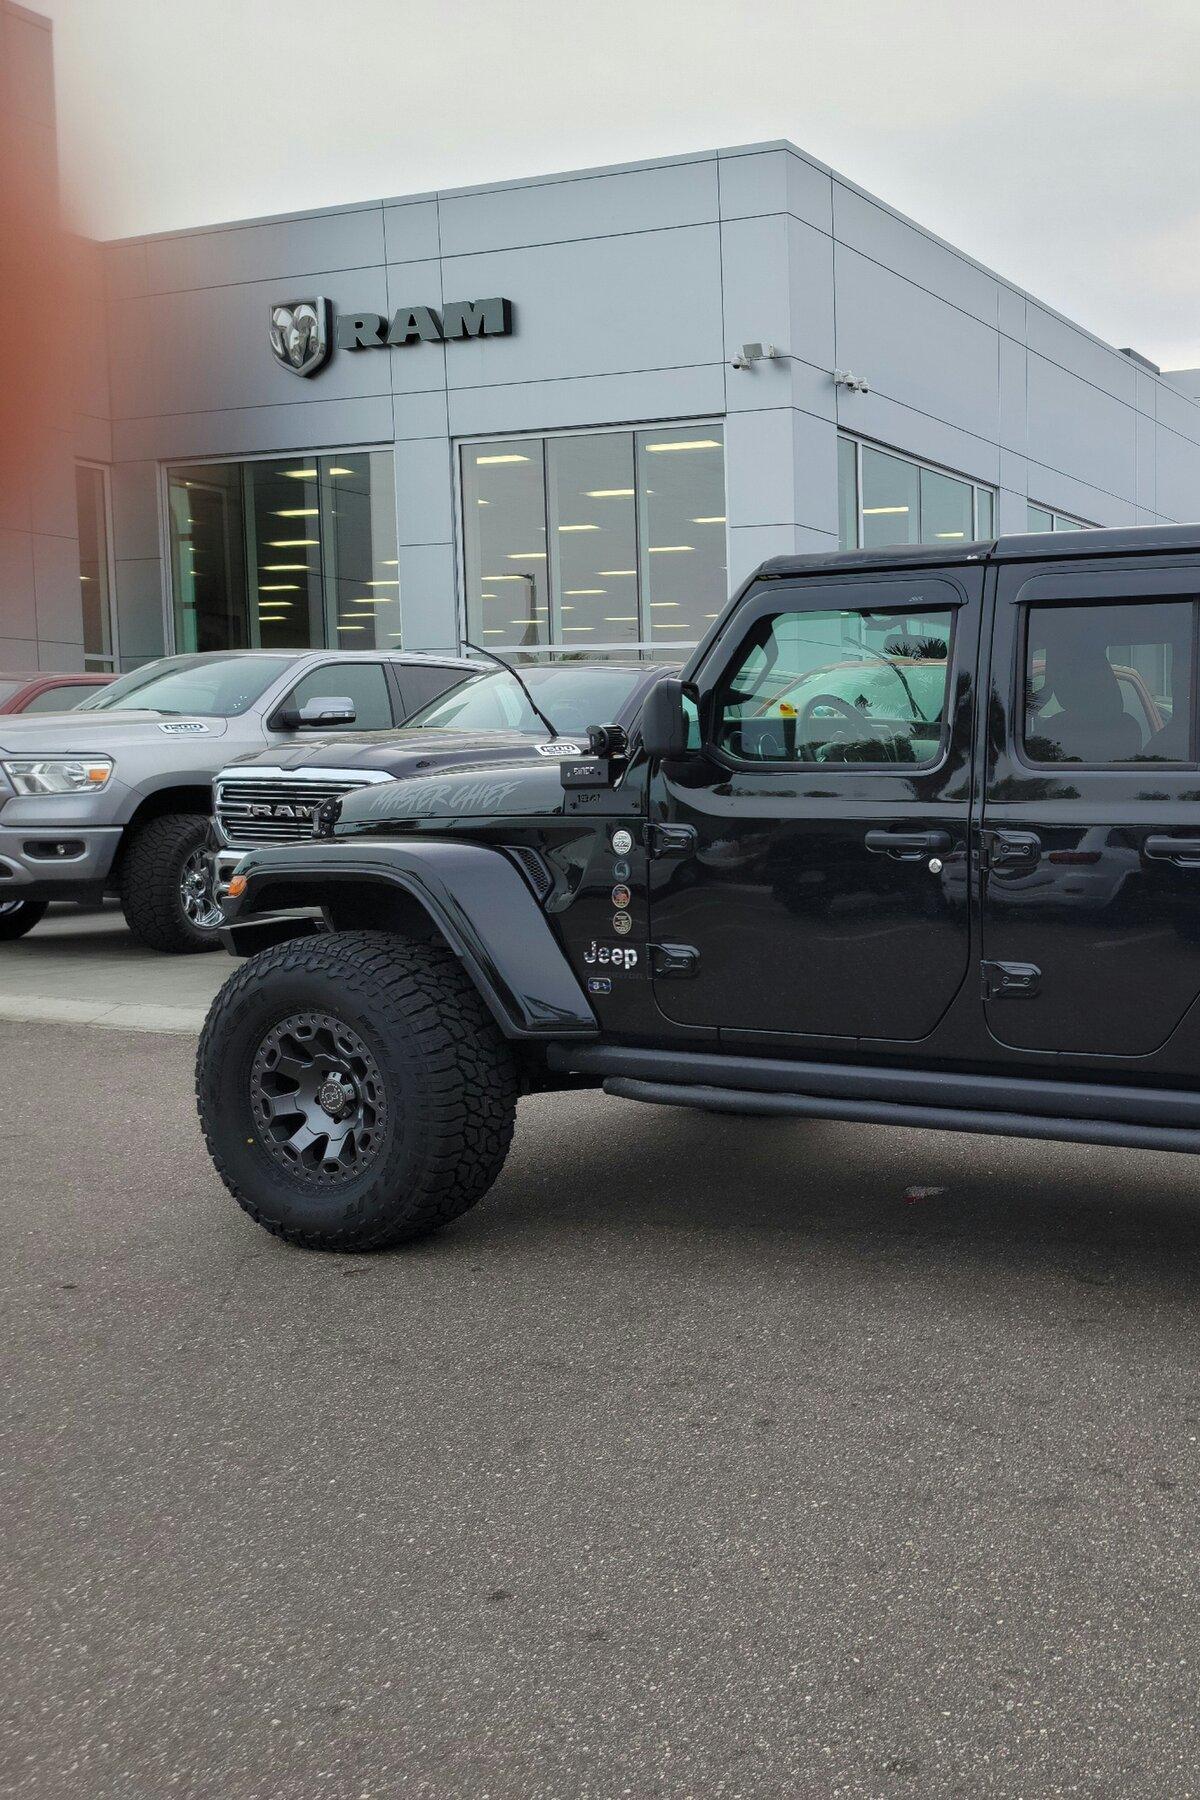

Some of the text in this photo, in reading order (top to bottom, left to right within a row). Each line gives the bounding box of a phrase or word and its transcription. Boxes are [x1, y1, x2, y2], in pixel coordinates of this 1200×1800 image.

[336, 297, 511, 350] RAM
[541, 745, 575, 753] 1500
[252, 803, 314, 817] RAM
[369, 780, 524, 814] MASTER CHIEF
[583, 940, 638, 970] Jeep
